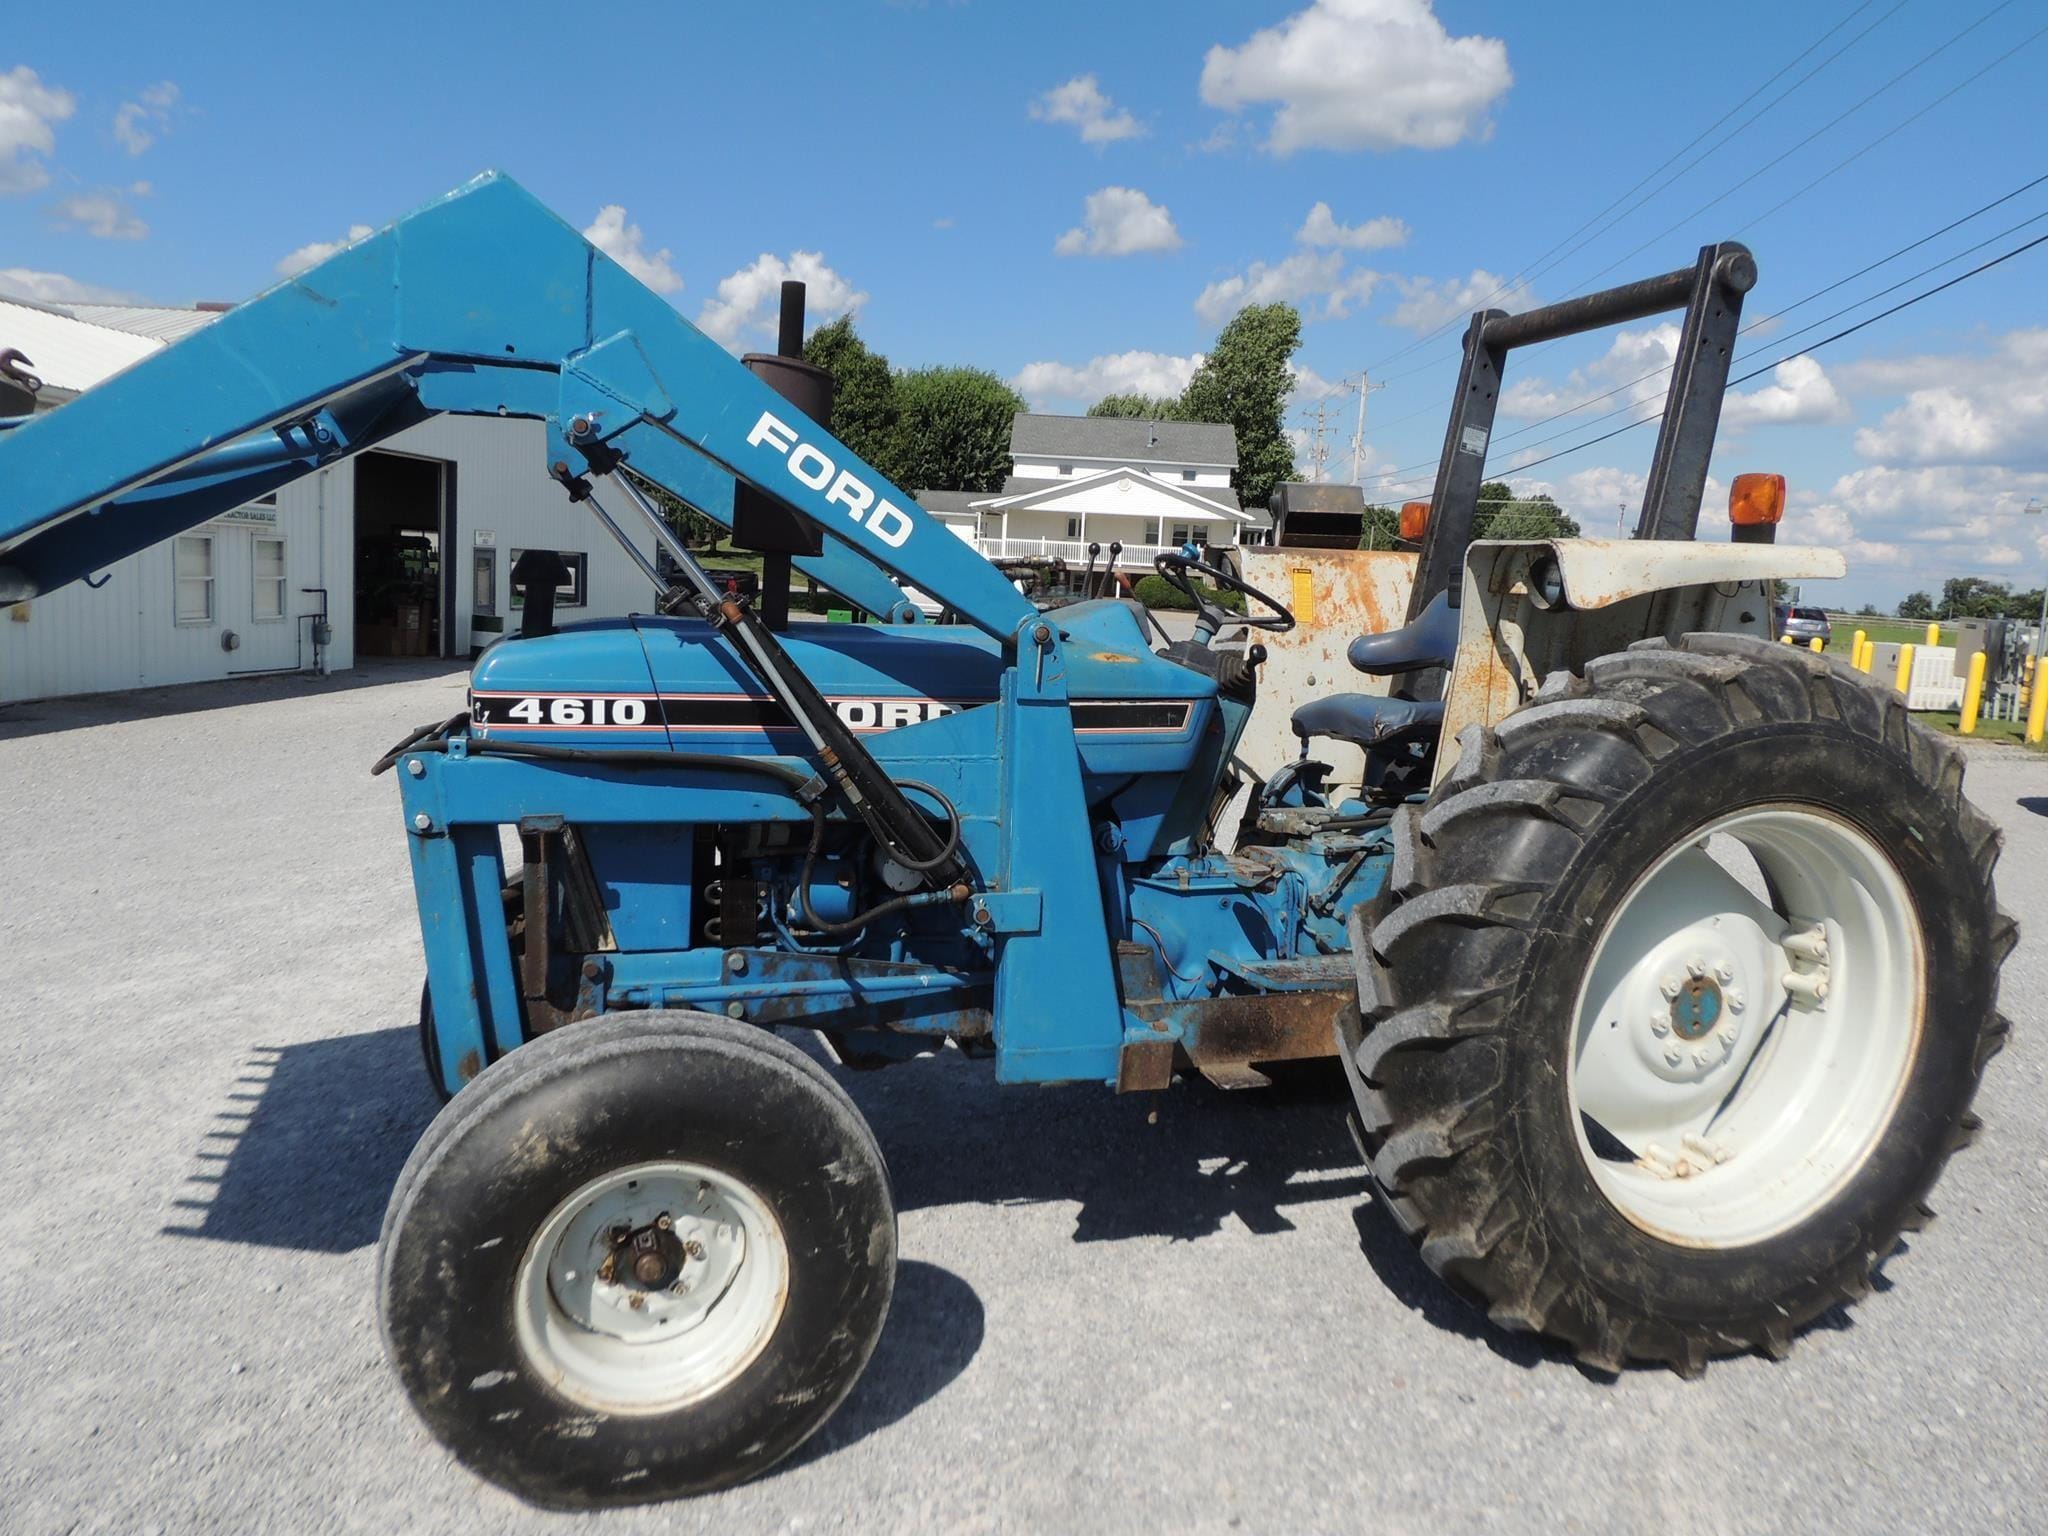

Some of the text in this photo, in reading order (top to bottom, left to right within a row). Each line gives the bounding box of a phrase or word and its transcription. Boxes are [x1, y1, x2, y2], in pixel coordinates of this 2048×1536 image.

[746, 411, 914, 548] FORD
[509, 699, 646, 725] 4610
[827, 702, 964, 727] ORD
